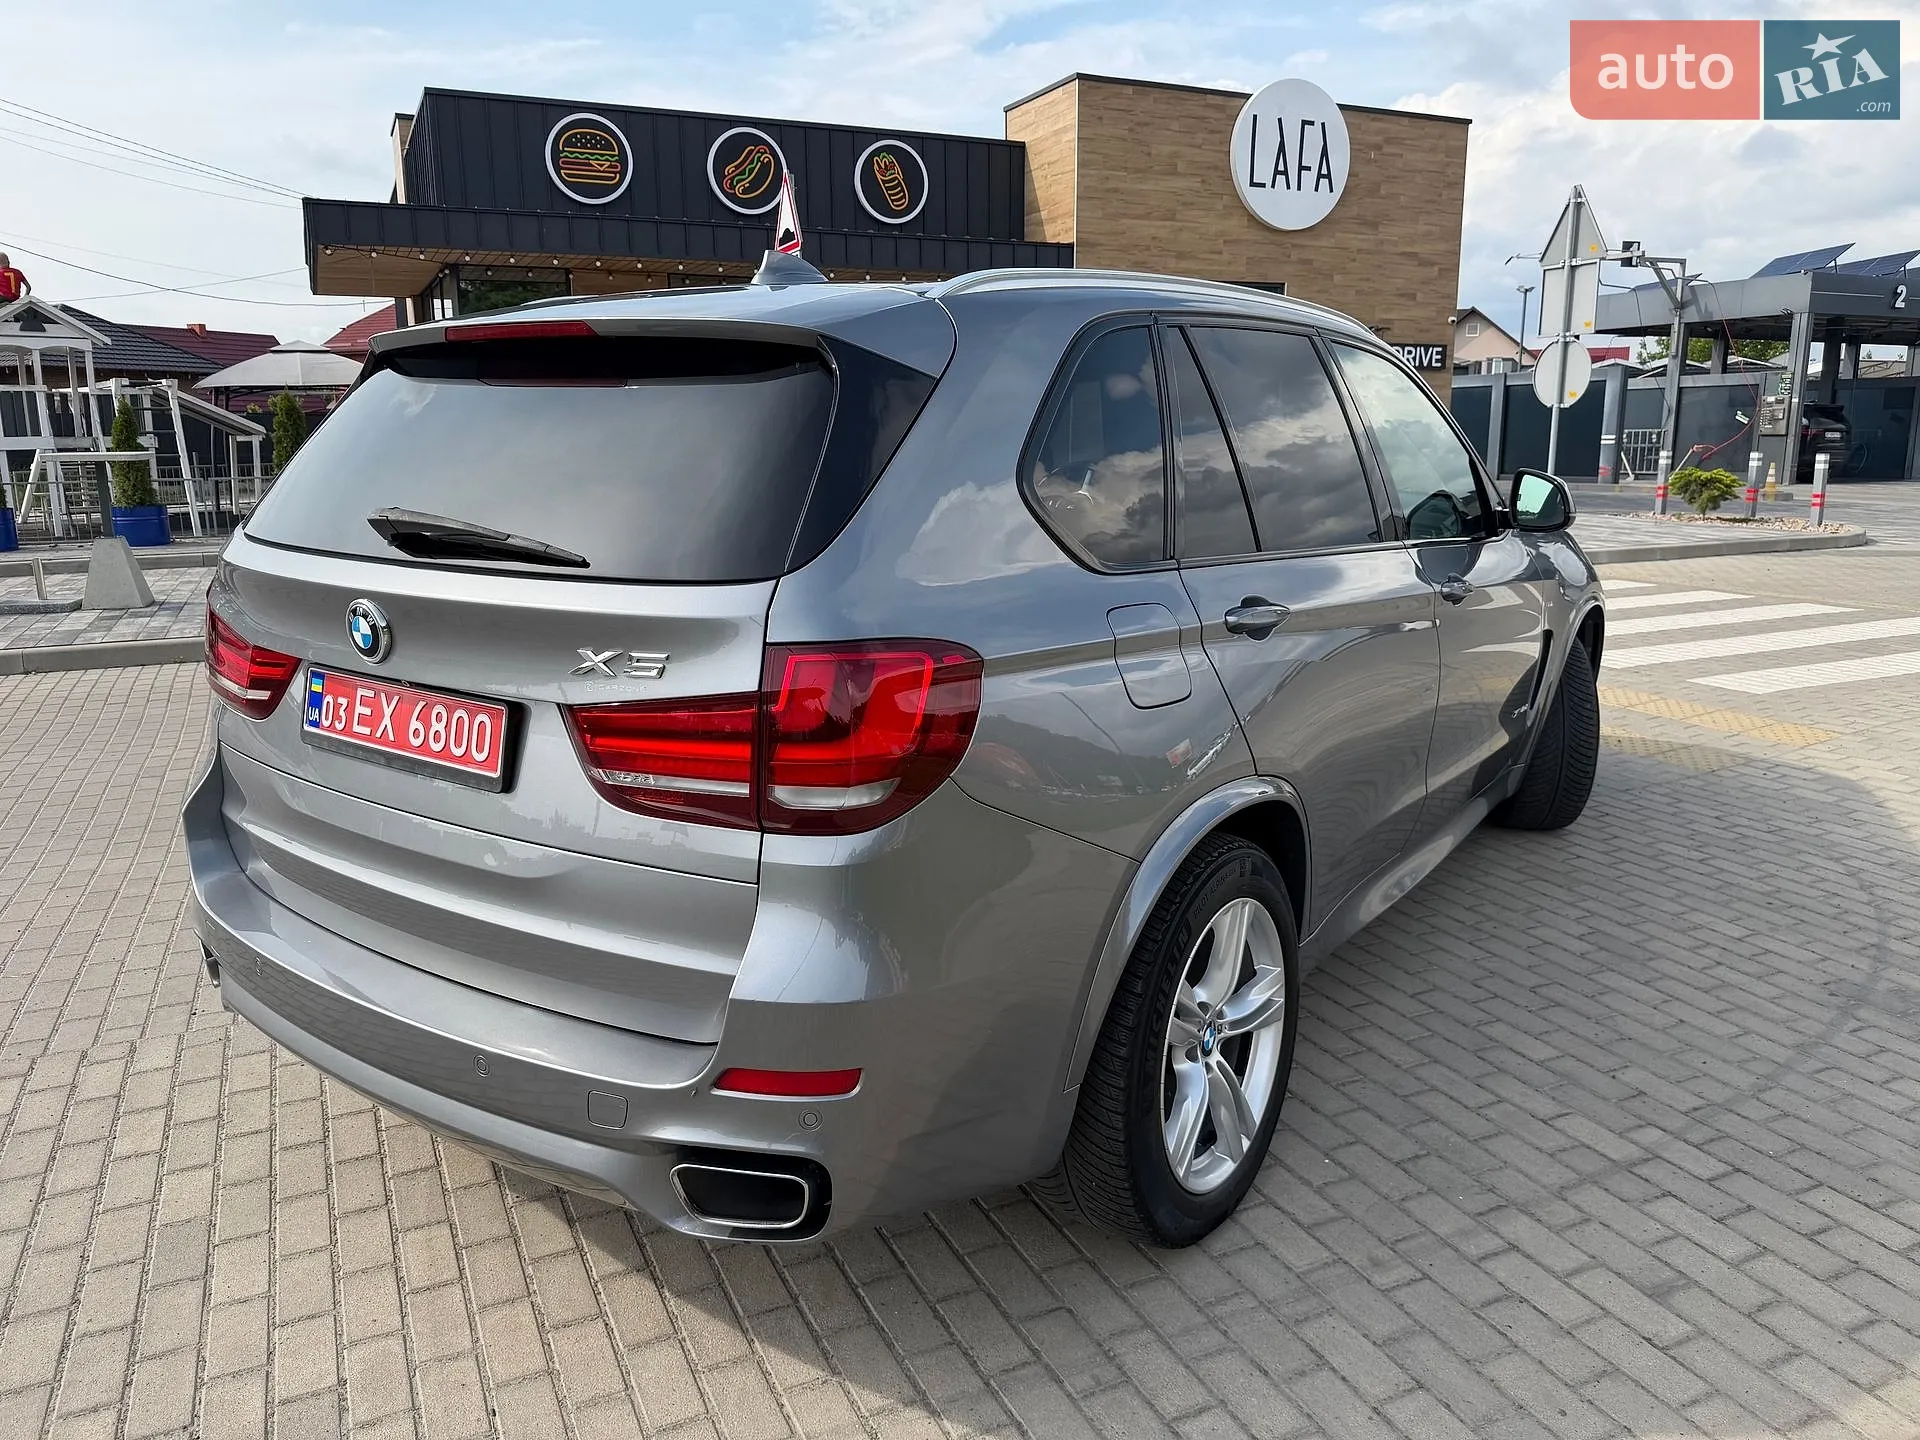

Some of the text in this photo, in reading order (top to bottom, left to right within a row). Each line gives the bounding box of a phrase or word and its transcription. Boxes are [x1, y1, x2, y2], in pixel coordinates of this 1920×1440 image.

[1249, 114, 1333, 193] LAFA
[1895, 285, 1906, 307] 2
[568, 648, 670, 679] X5
[308, 707, 320, 723] UA
[321, 687, 493, 763] 03 EX 6800
